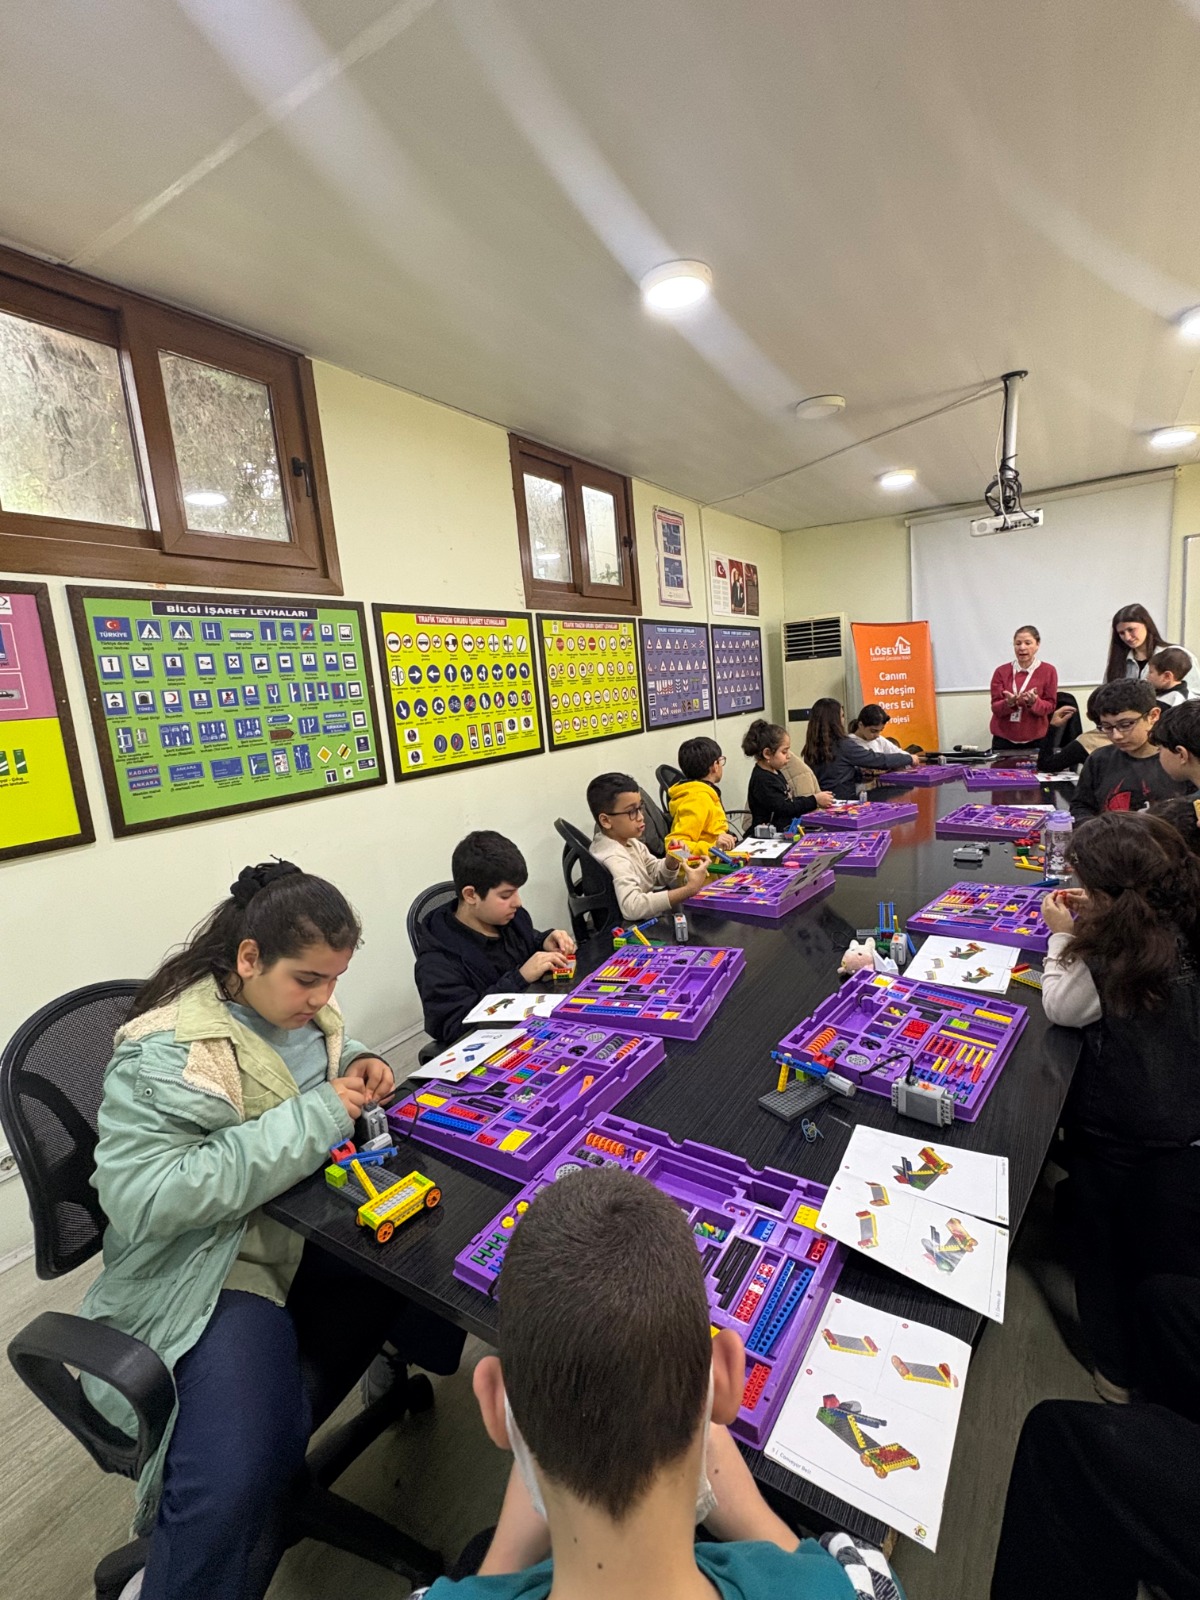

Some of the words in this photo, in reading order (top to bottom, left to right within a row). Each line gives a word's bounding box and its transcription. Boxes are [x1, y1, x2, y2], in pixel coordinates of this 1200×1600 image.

[166, 604, 201, 614] BİLGİ
[204, 605, 248, 616] İŞARET
[250, 608, 309, 617] LEVHALARI
[869, 646, 899, 656] LÖSEV
[879, 672, 907, 681] Canım
[873, 685, 915, 696] Kardeşim
[508, 693, 518, 705] 30
[878, 701, 899, 710] Ders
[901, 699, 914, 709] Evi
[887, 715, 910, 725] rojesi
[132, 780, 159, 789] ANKARA
[779, 1452, 802, 1468] Conveyor
[801, 1465, 812, 1474] Belt
